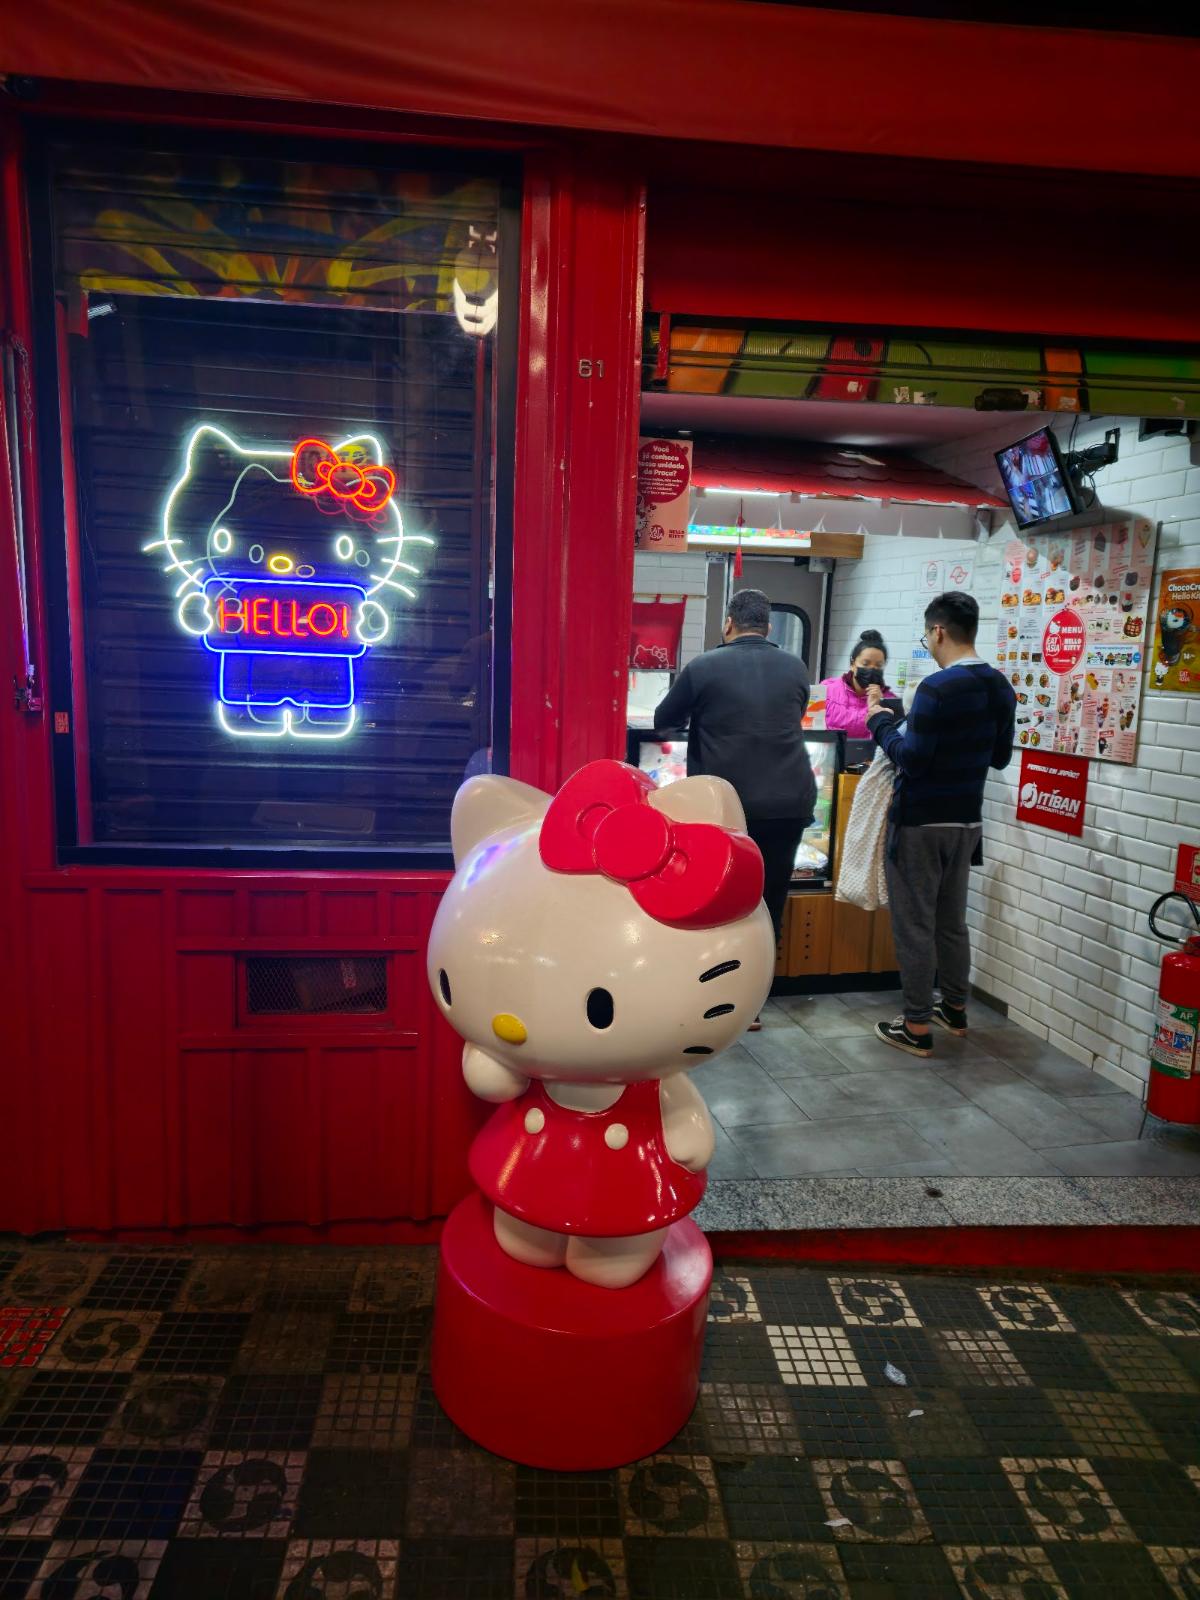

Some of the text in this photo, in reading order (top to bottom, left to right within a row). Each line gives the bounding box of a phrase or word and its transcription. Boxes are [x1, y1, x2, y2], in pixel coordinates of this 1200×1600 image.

[579, 359, 603, 378] 61
[654, 469, 677, 477] Praça?
[1171, 591, 1191, 600] Hello
[219, 597, 349, 638] HELLO!
[1062, 626, 1083, 634] MENU
[1179, 1011, 1194, 1020] AP
